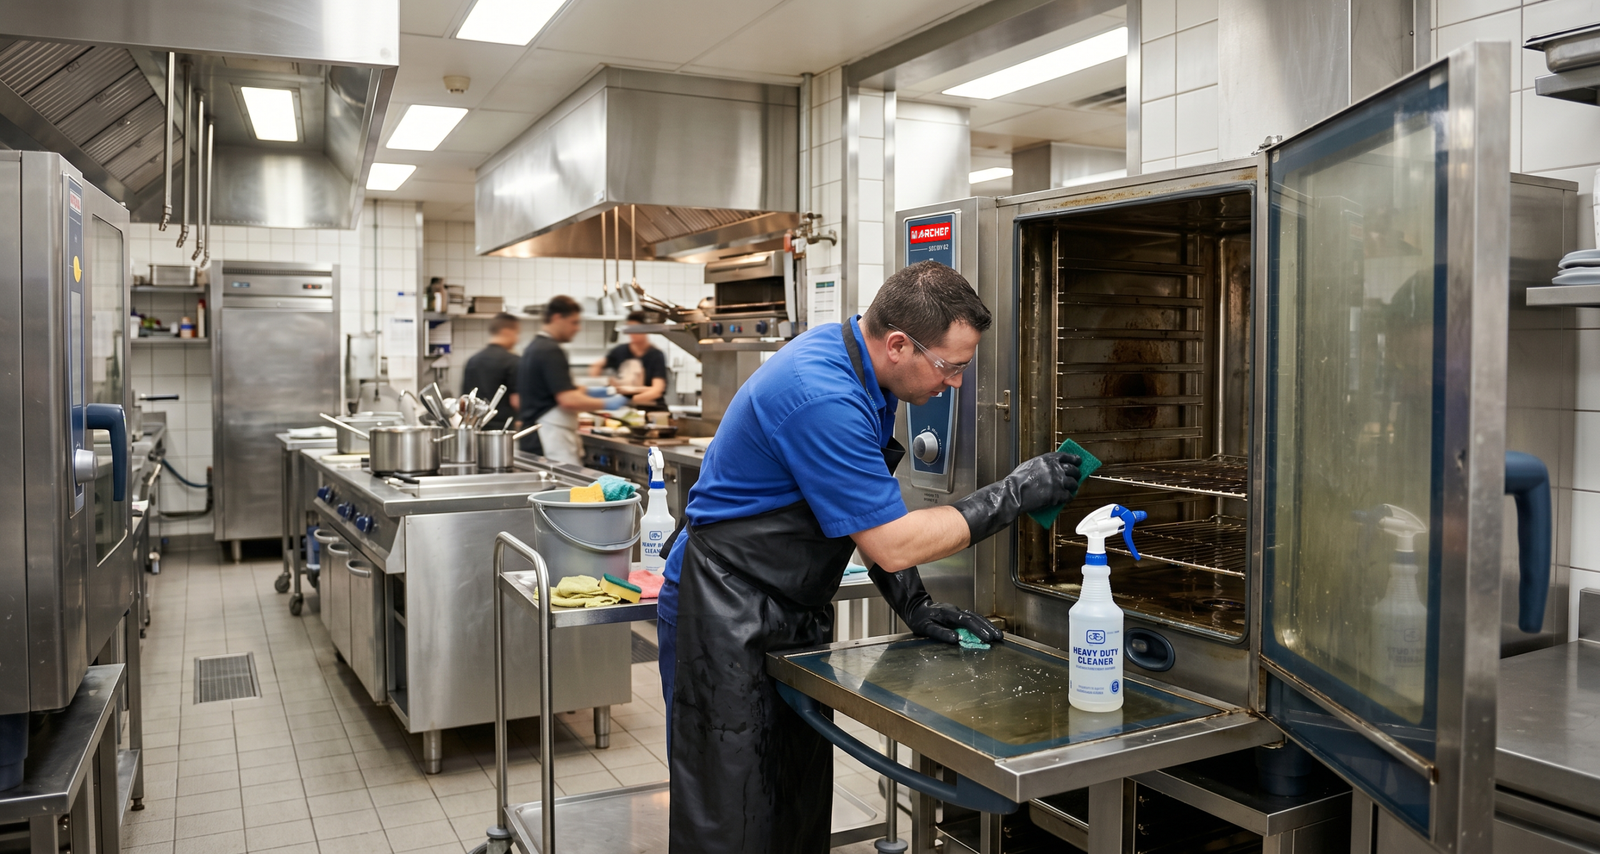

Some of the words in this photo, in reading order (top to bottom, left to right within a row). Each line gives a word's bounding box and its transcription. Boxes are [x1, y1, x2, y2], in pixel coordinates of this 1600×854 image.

[1073, 646, 1097, 657] HEAVY
[1100, 648, 1119, 657] DUTY
[1077, 656, 1114, 666] CLEANER
